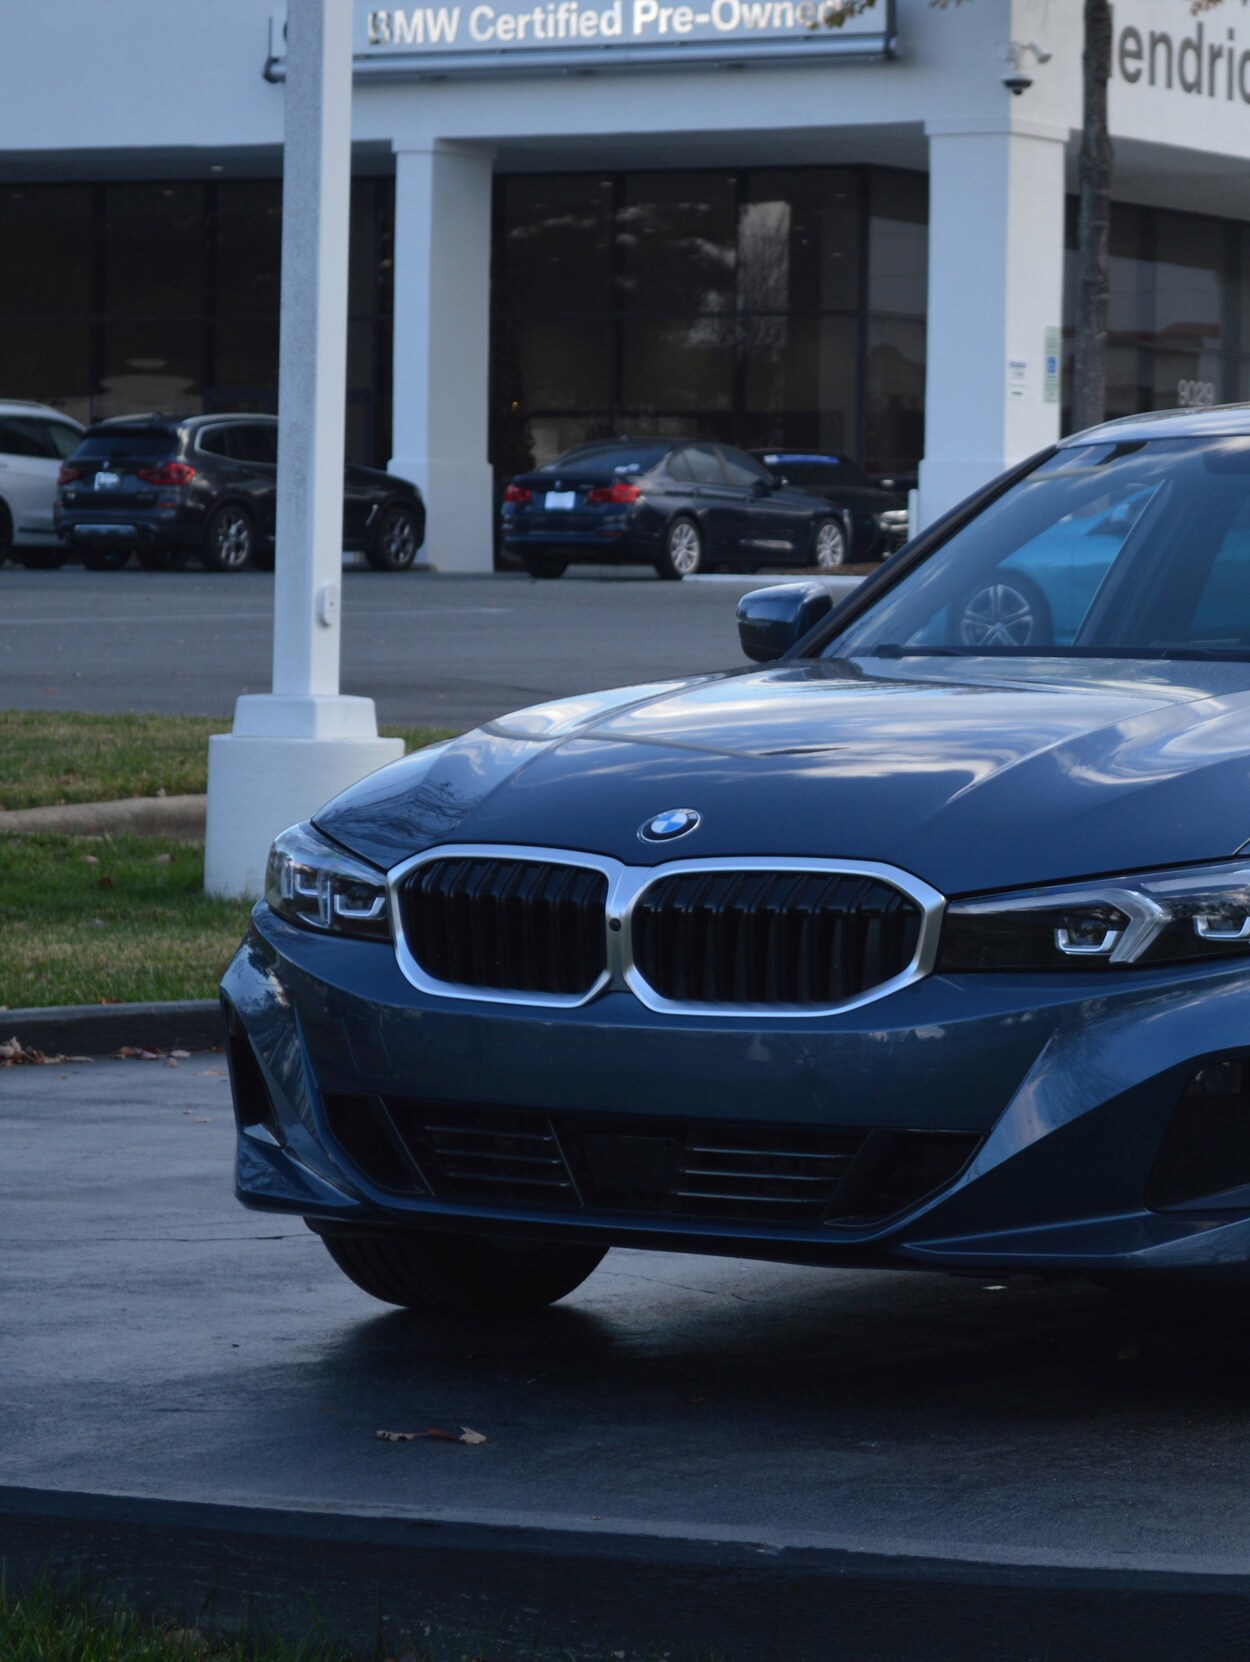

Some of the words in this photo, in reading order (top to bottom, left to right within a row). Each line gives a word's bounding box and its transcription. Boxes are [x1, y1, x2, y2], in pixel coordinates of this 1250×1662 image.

[367, 8, 461, 45] BMW
[468, 0, 623, 42] Certified
[1177, 379, 1215, 407] 9029
